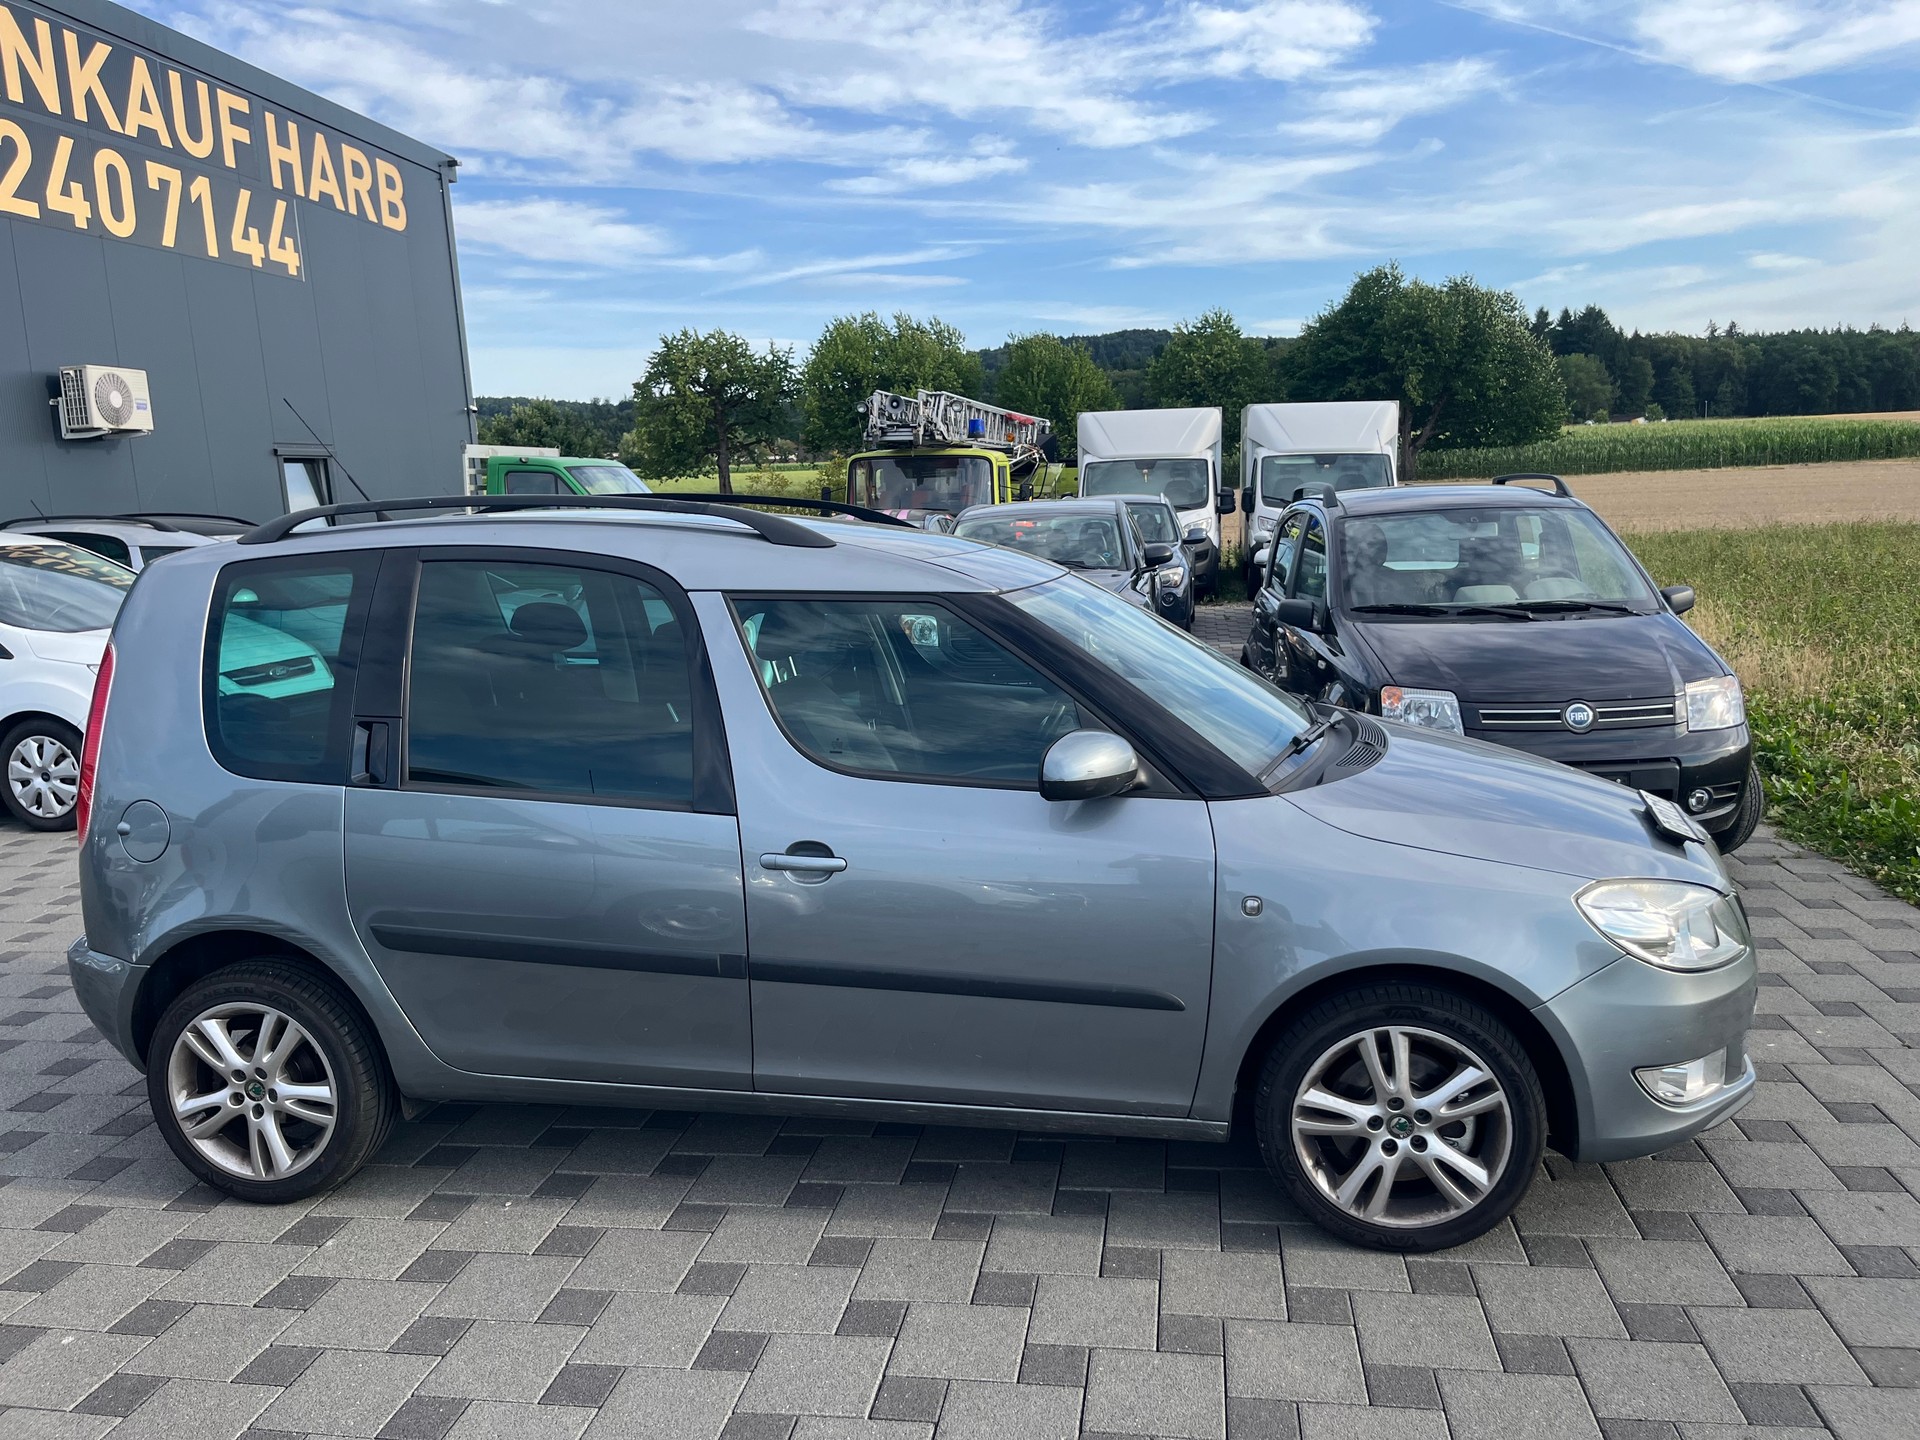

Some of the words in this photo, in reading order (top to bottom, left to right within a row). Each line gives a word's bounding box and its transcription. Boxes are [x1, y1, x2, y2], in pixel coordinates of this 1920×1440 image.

[264, 111, 408, 232] HARB
[1570, 711, 1588, 721] FIAT
[1442, 1016, 1502, 1058] NEXEN
